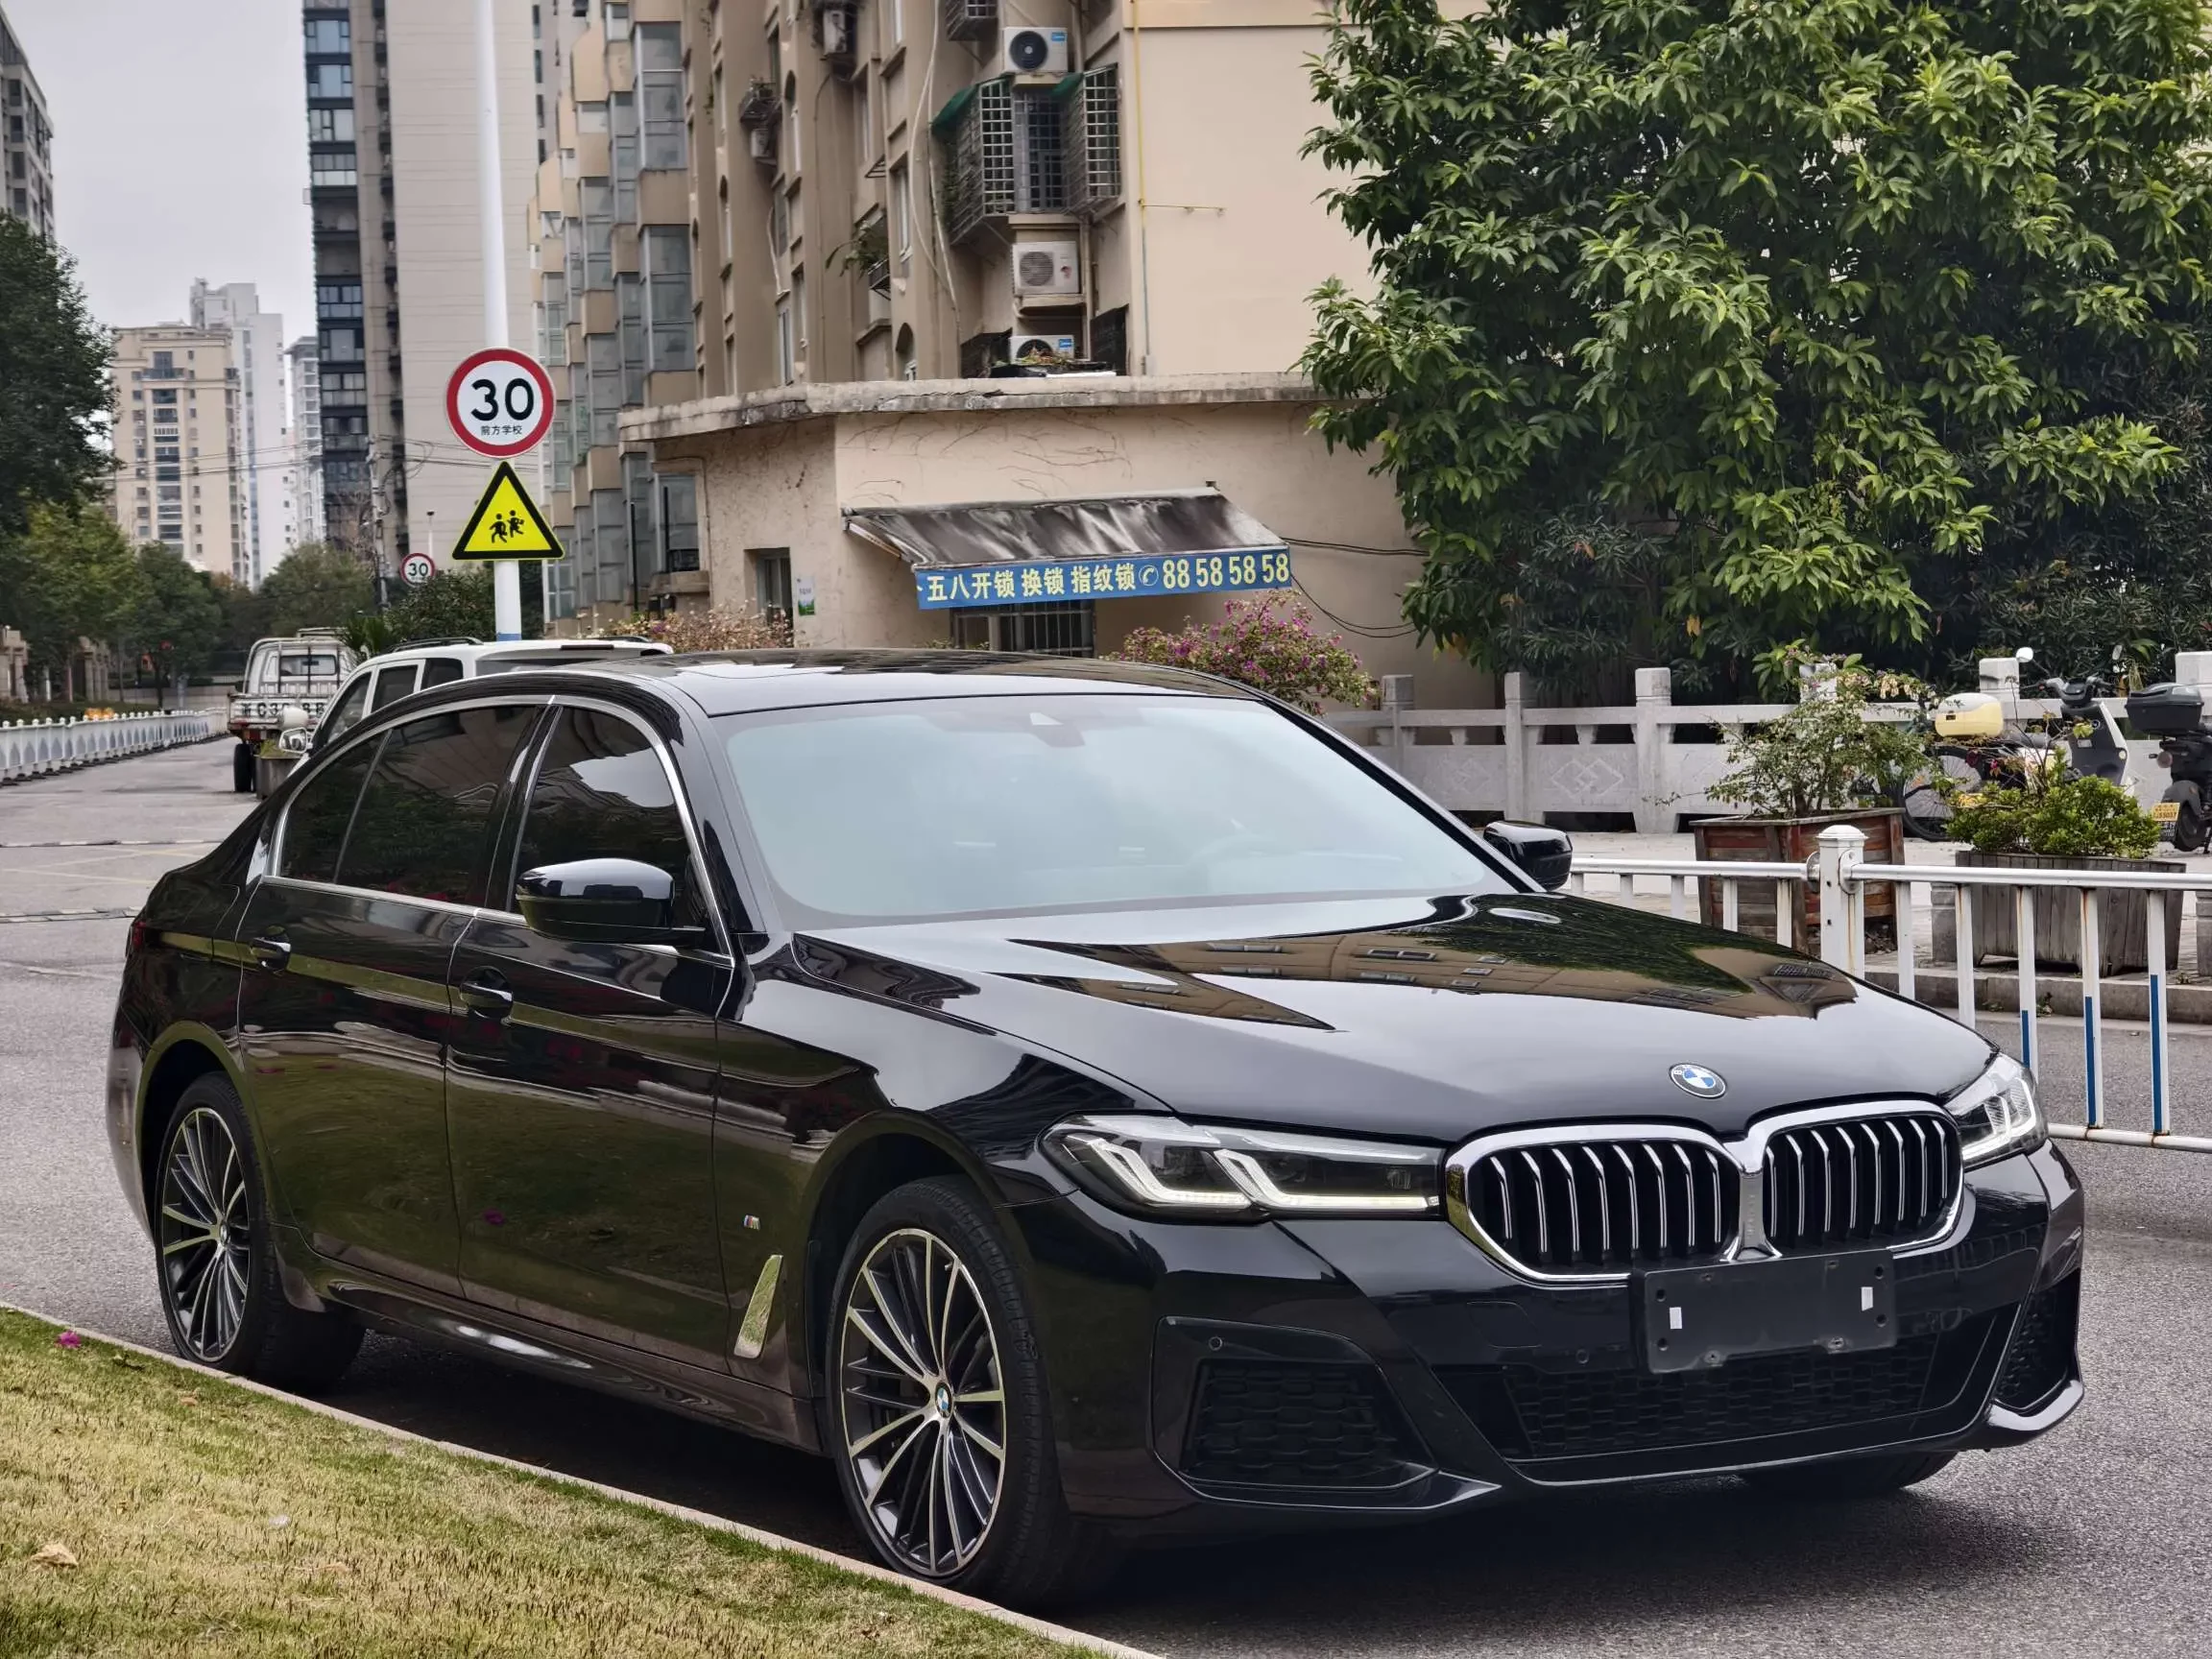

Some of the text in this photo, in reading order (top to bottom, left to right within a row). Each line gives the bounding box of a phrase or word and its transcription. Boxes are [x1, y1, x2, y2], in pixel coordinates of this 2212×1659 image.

[471, 378, 534, 421] 30
[408, 563, 428, 576] 30
[926, 553, 1289, 602] 五八开锁 换锁 指纹锁 88 58 58 58
